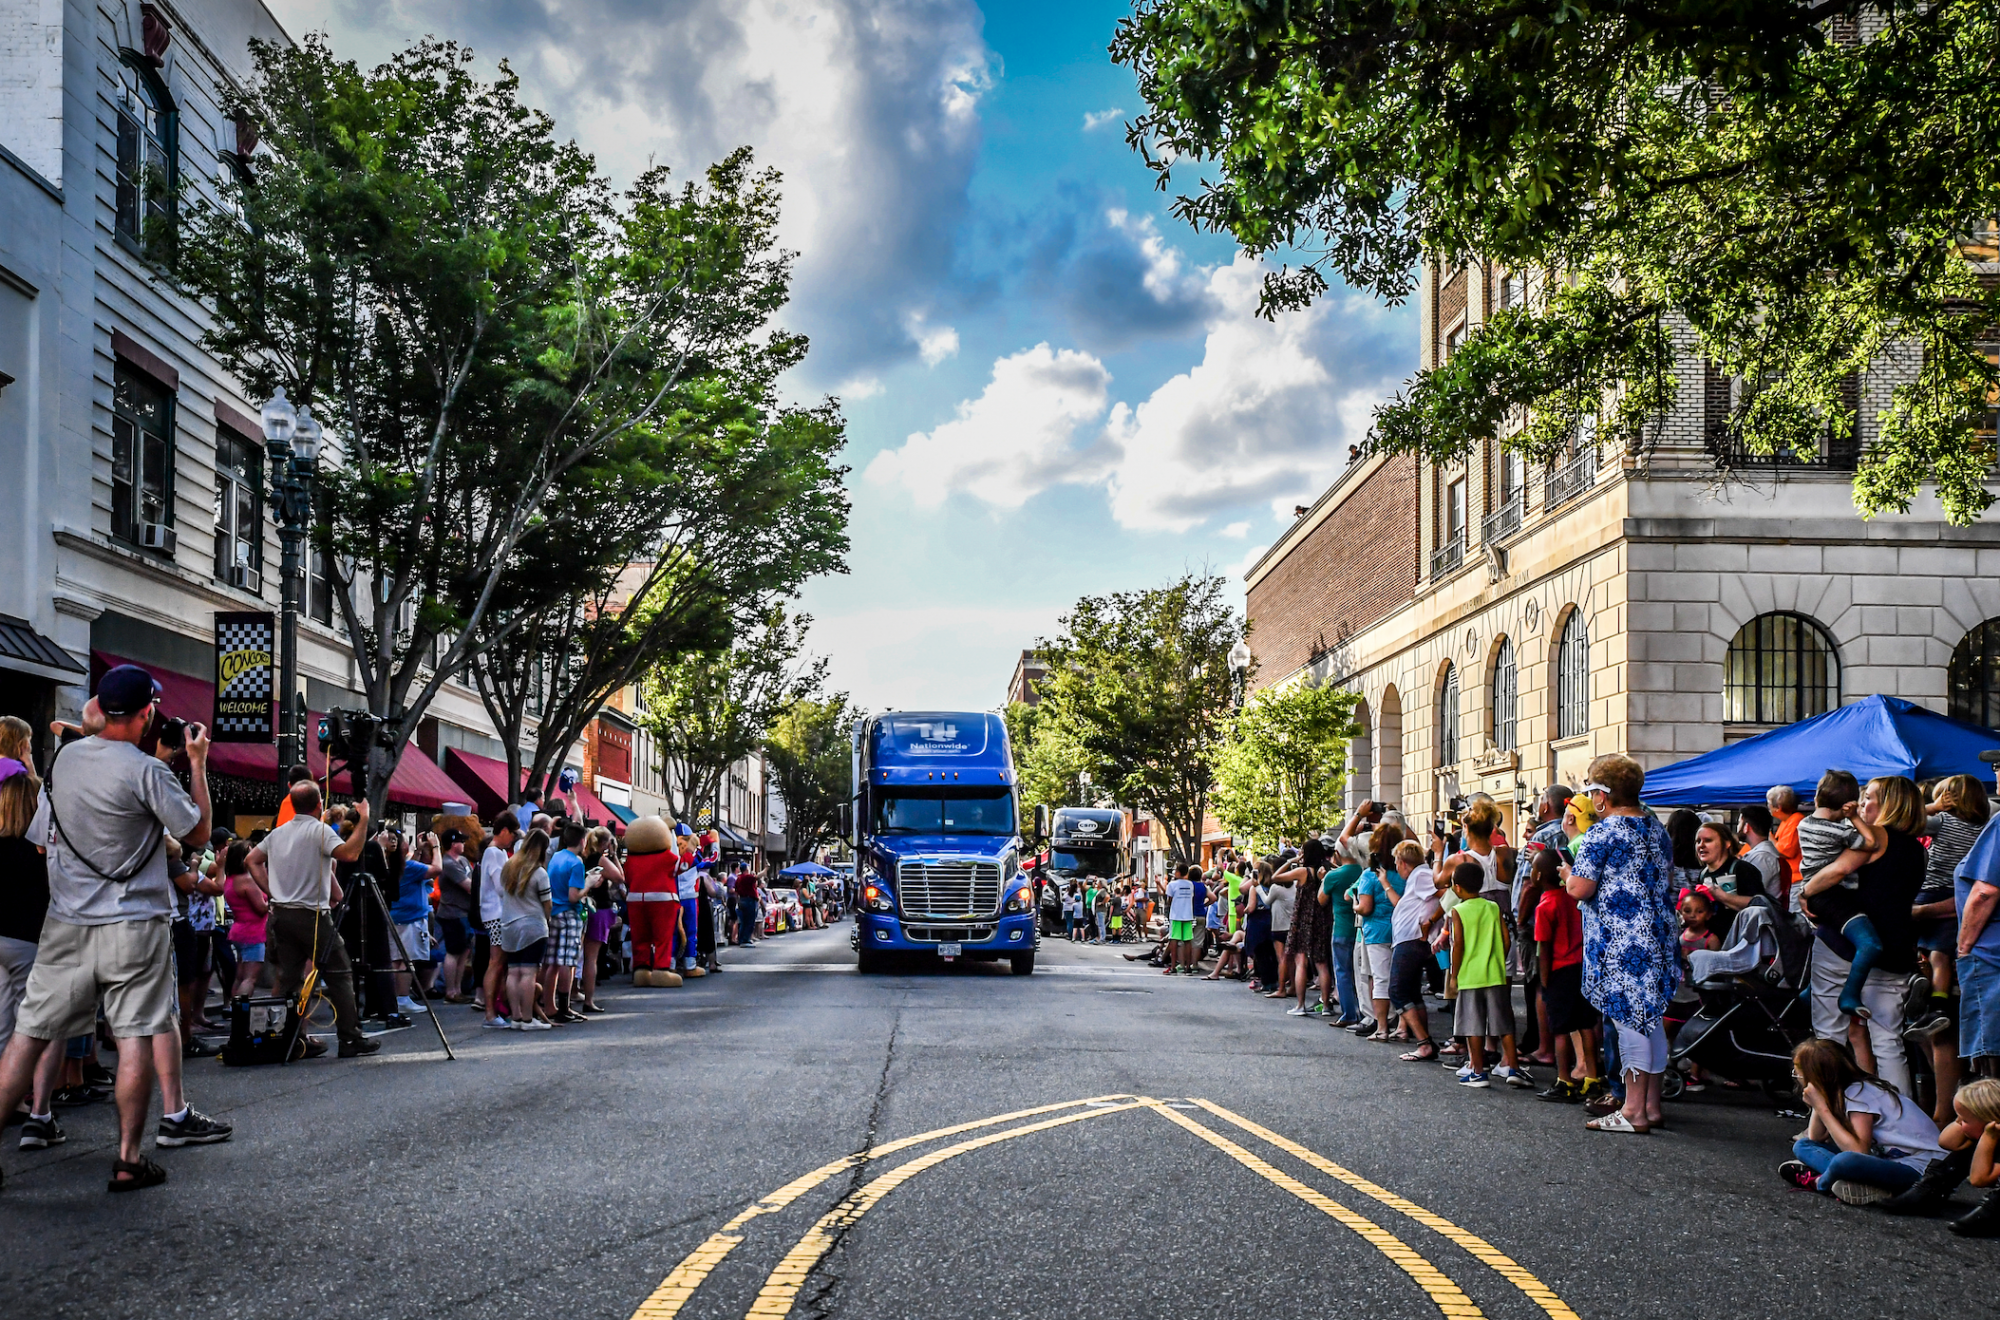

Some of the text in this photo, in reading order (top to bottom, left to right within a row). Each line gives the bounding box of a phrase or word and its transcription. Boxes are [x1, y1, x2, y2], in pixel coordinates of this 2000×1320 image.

[1514, 569, 1530, 587] BANK
[221, 652, 269, 681] CONCORD
[219, 702, 268, 714] WELCOME
